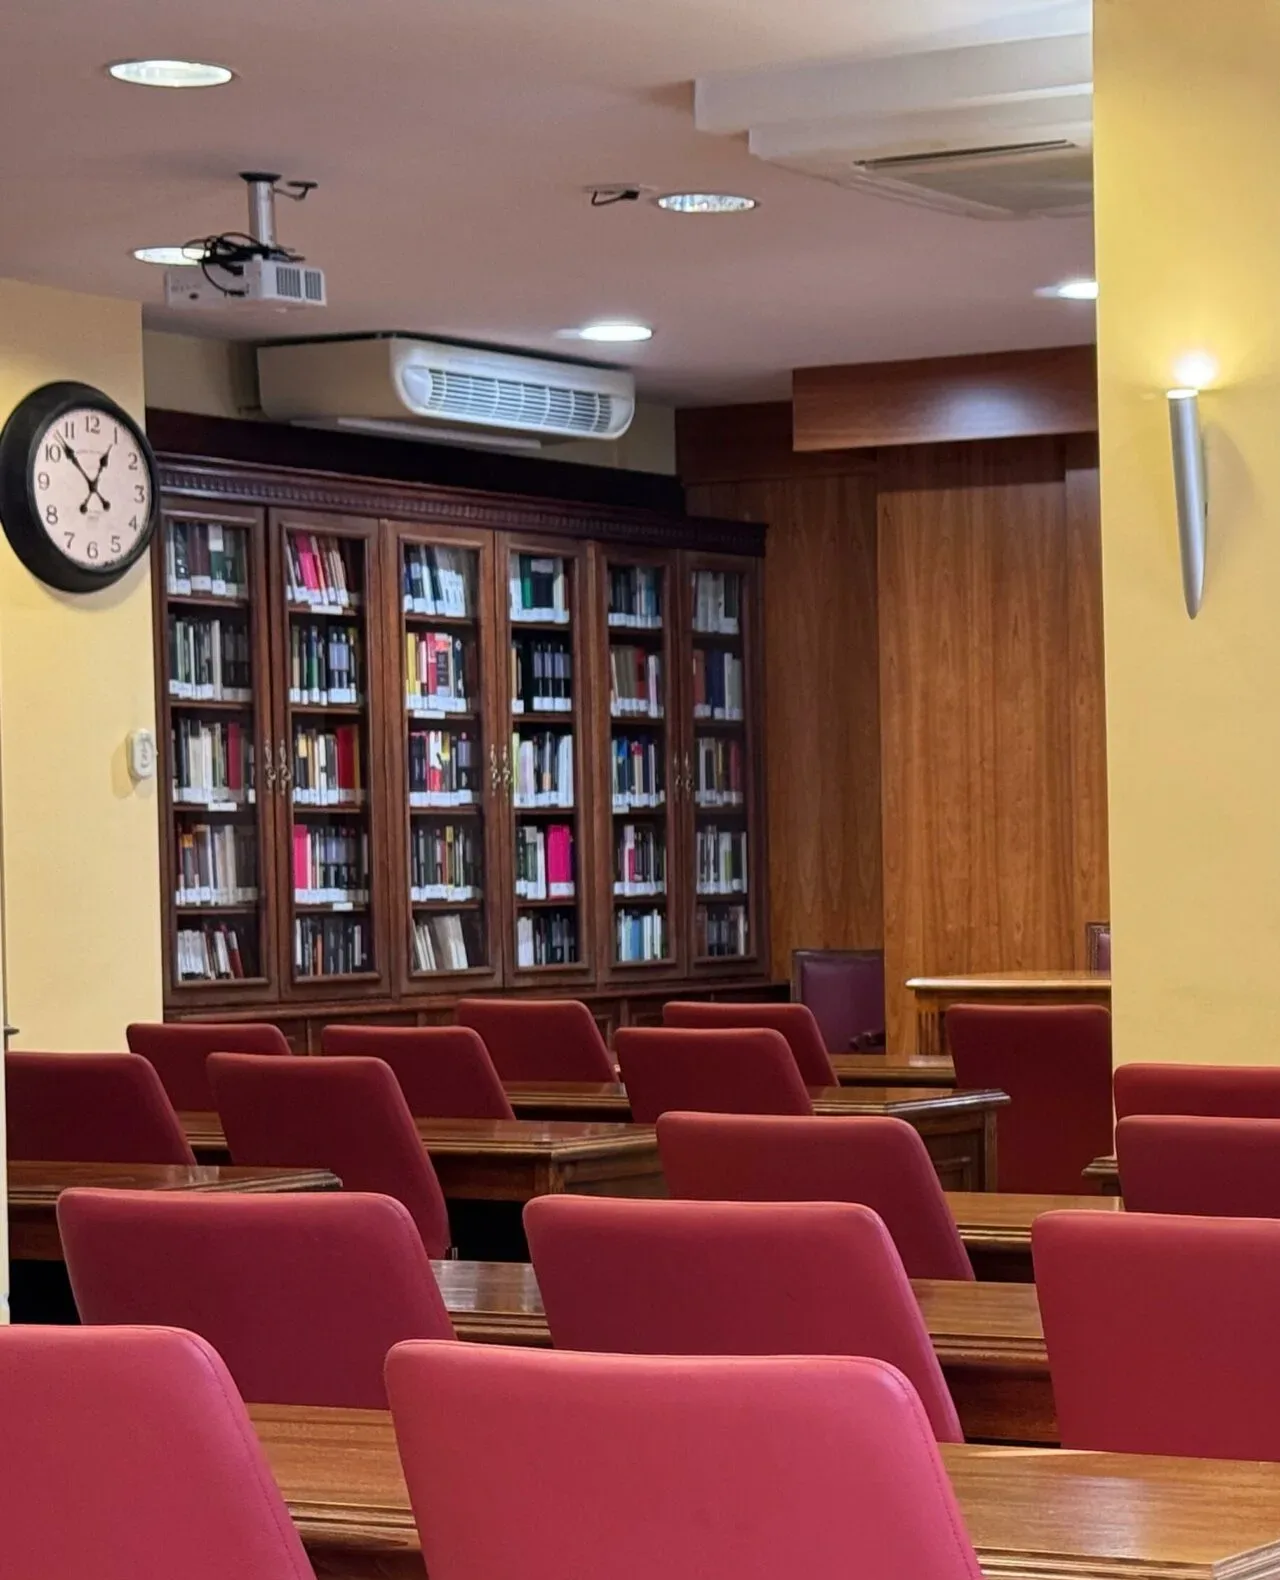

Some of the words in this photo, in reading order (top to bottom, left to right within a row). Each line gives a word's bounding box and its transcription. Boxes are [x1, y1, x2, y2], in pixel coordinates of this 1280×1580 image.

[64, 421, 76, 440] 11
[85, 415, 101, 434] 12
[113, 426, 118, 444] 1
[45, 444, 61, 463] 10
[128, 452, 139, 471] 2
[38, 472, 50, 491] 9
[134, 485, 145, 504] 3
[46, 505, 58, 525] 8
[128, 515, 138, 532] 4
[64, 531, 76, 550] 7
[87, 541, 99, 559] 6
[111, 535, 121, 554] 5
